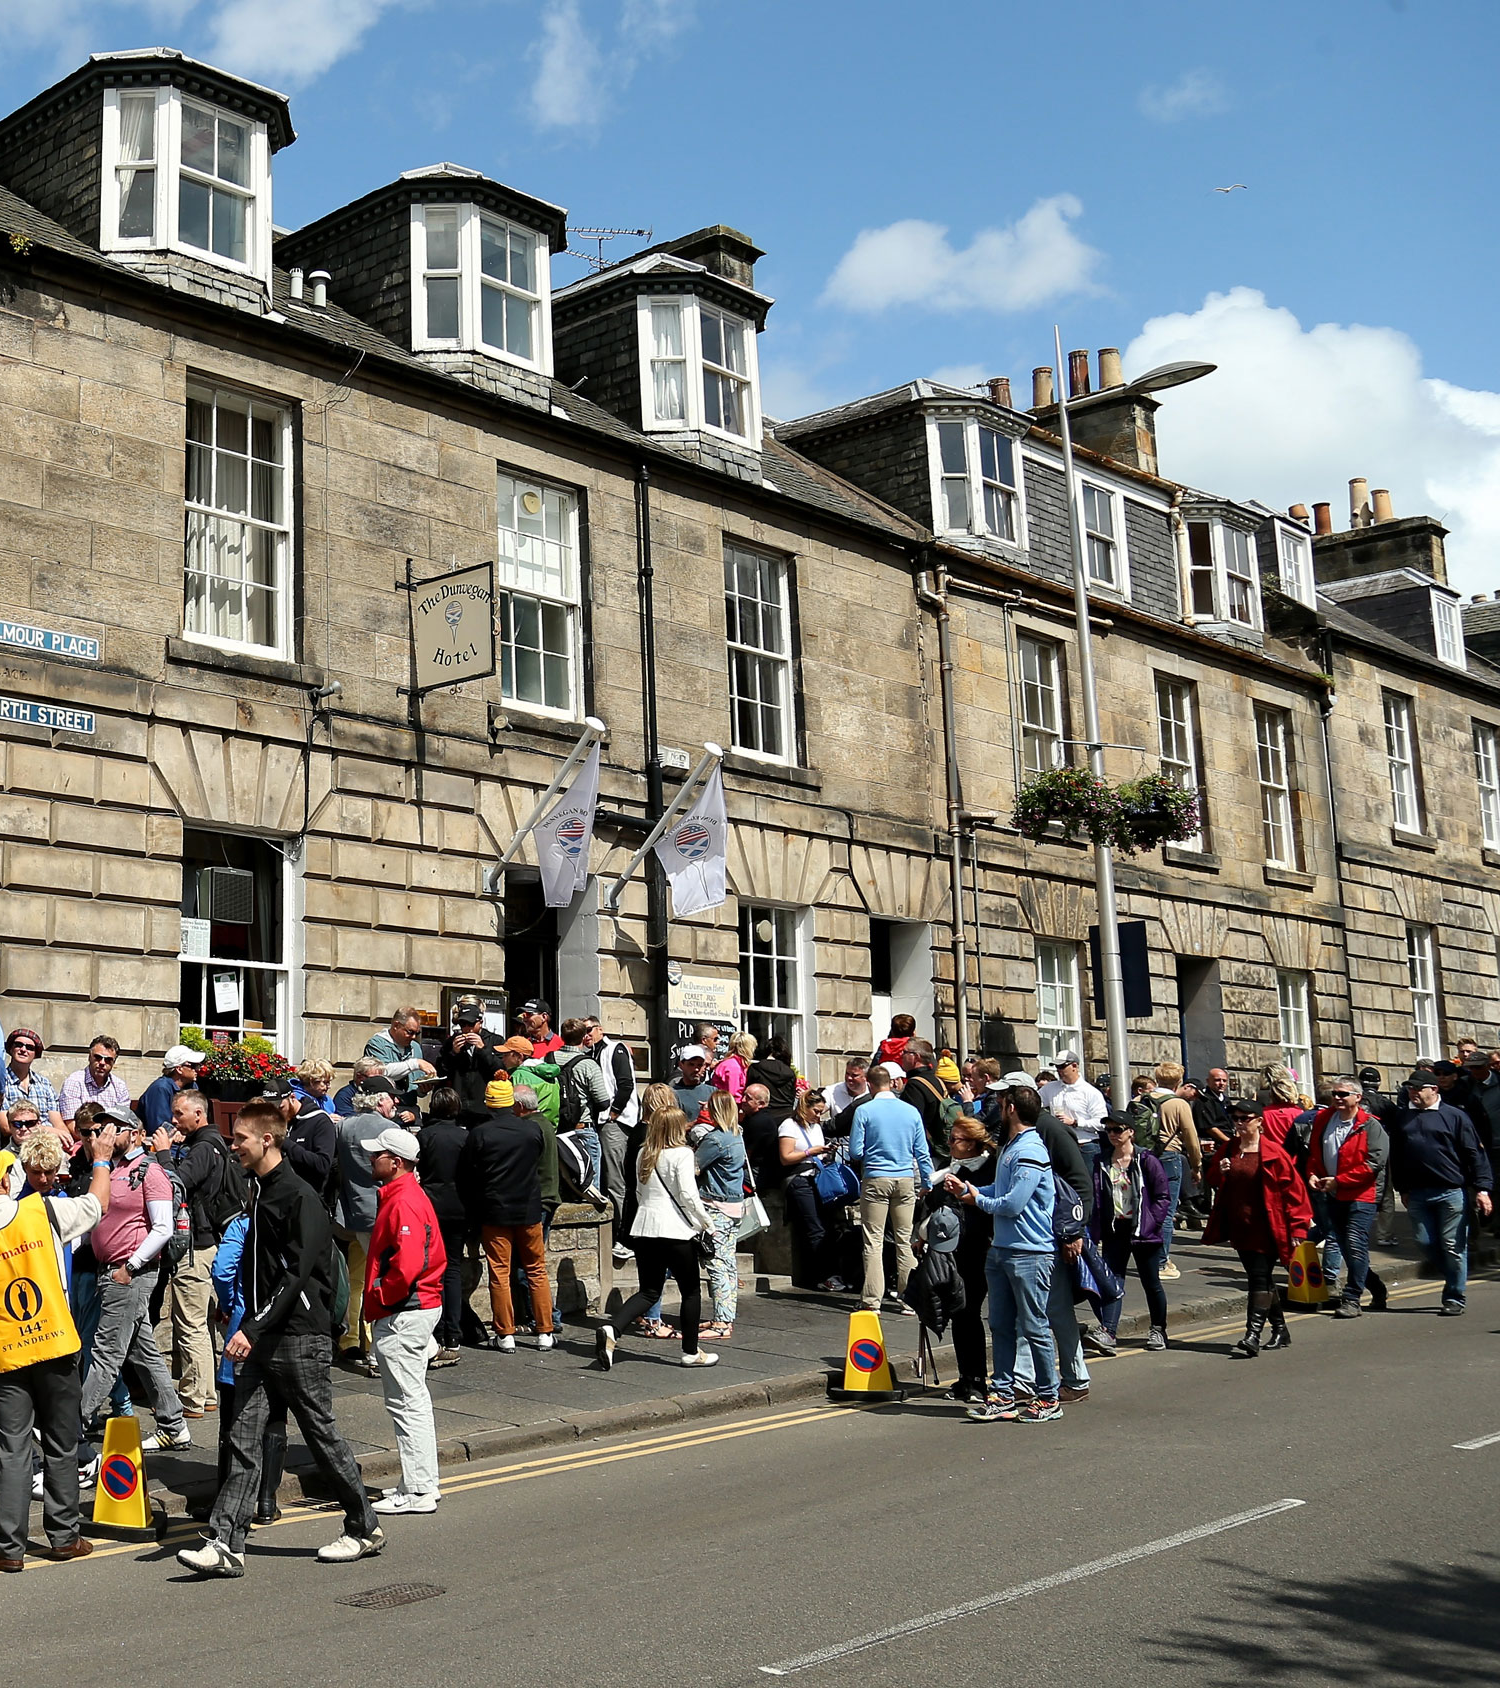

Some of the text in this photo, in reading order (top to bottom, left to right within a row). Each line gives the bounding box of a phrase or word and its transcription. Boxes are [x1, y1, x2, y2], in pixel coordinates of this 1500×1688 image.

[418, 584, 492, 615] The Dunvegan
[52, 634, 95, 657] PLACE
[432, 642, 478, 667] Hotel
[37, 707, 91, 731] STREET
[543, 807, 579, 829] DUNVEGAN
[2, 1329, 65, 1353] ST ANDREWS
